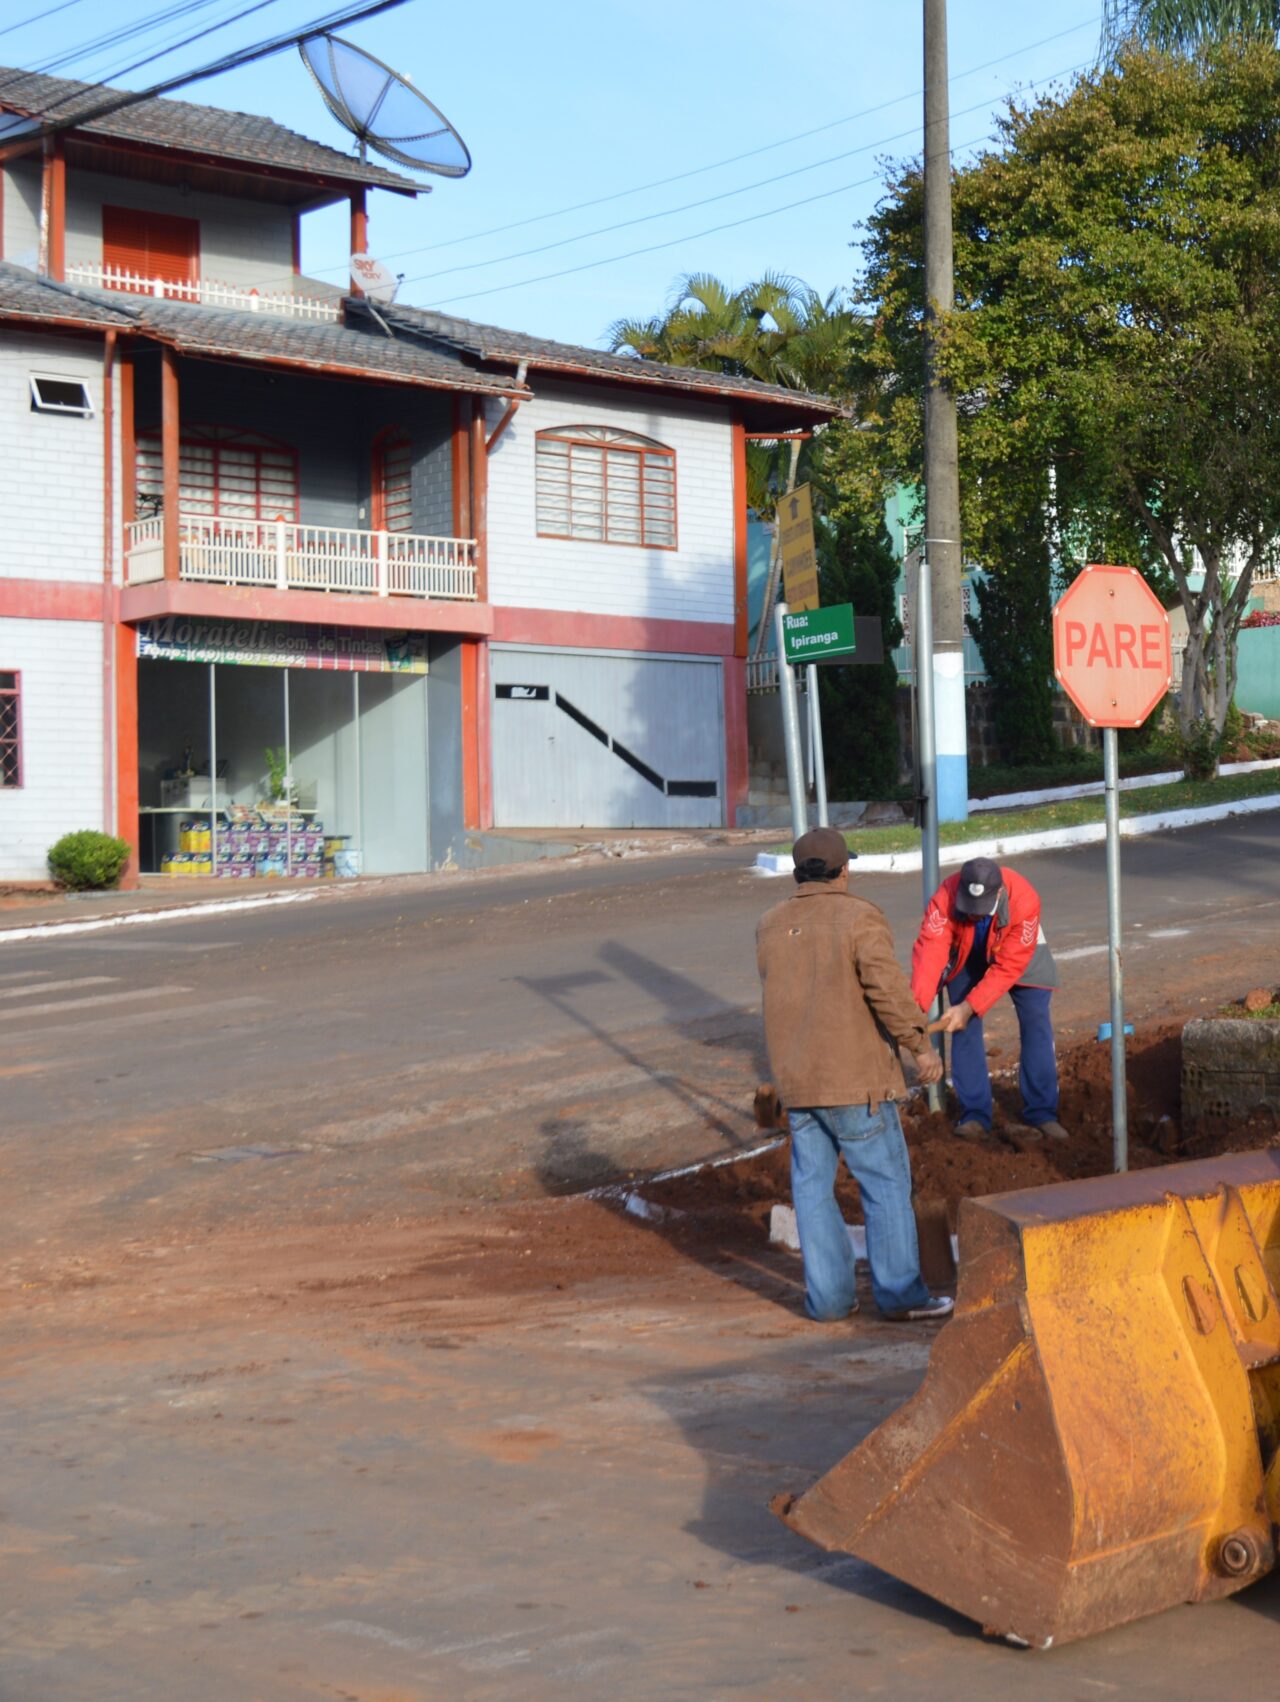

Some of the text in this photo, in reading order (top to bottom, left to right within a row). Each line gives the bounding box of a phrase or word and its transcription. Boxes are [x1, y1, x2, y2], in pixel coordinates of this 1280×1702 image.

[354, 259, 375, 271] SKY
[786, 615, 809, 630] Rua:
[275, 632, 313, 650] Com.
[317, 635, 335, 652] de
[338, 635, 382, 654] Tintas
[791, 631, 839, 649] Ipiranga
[1065, 621, 1163, 670] PARE
